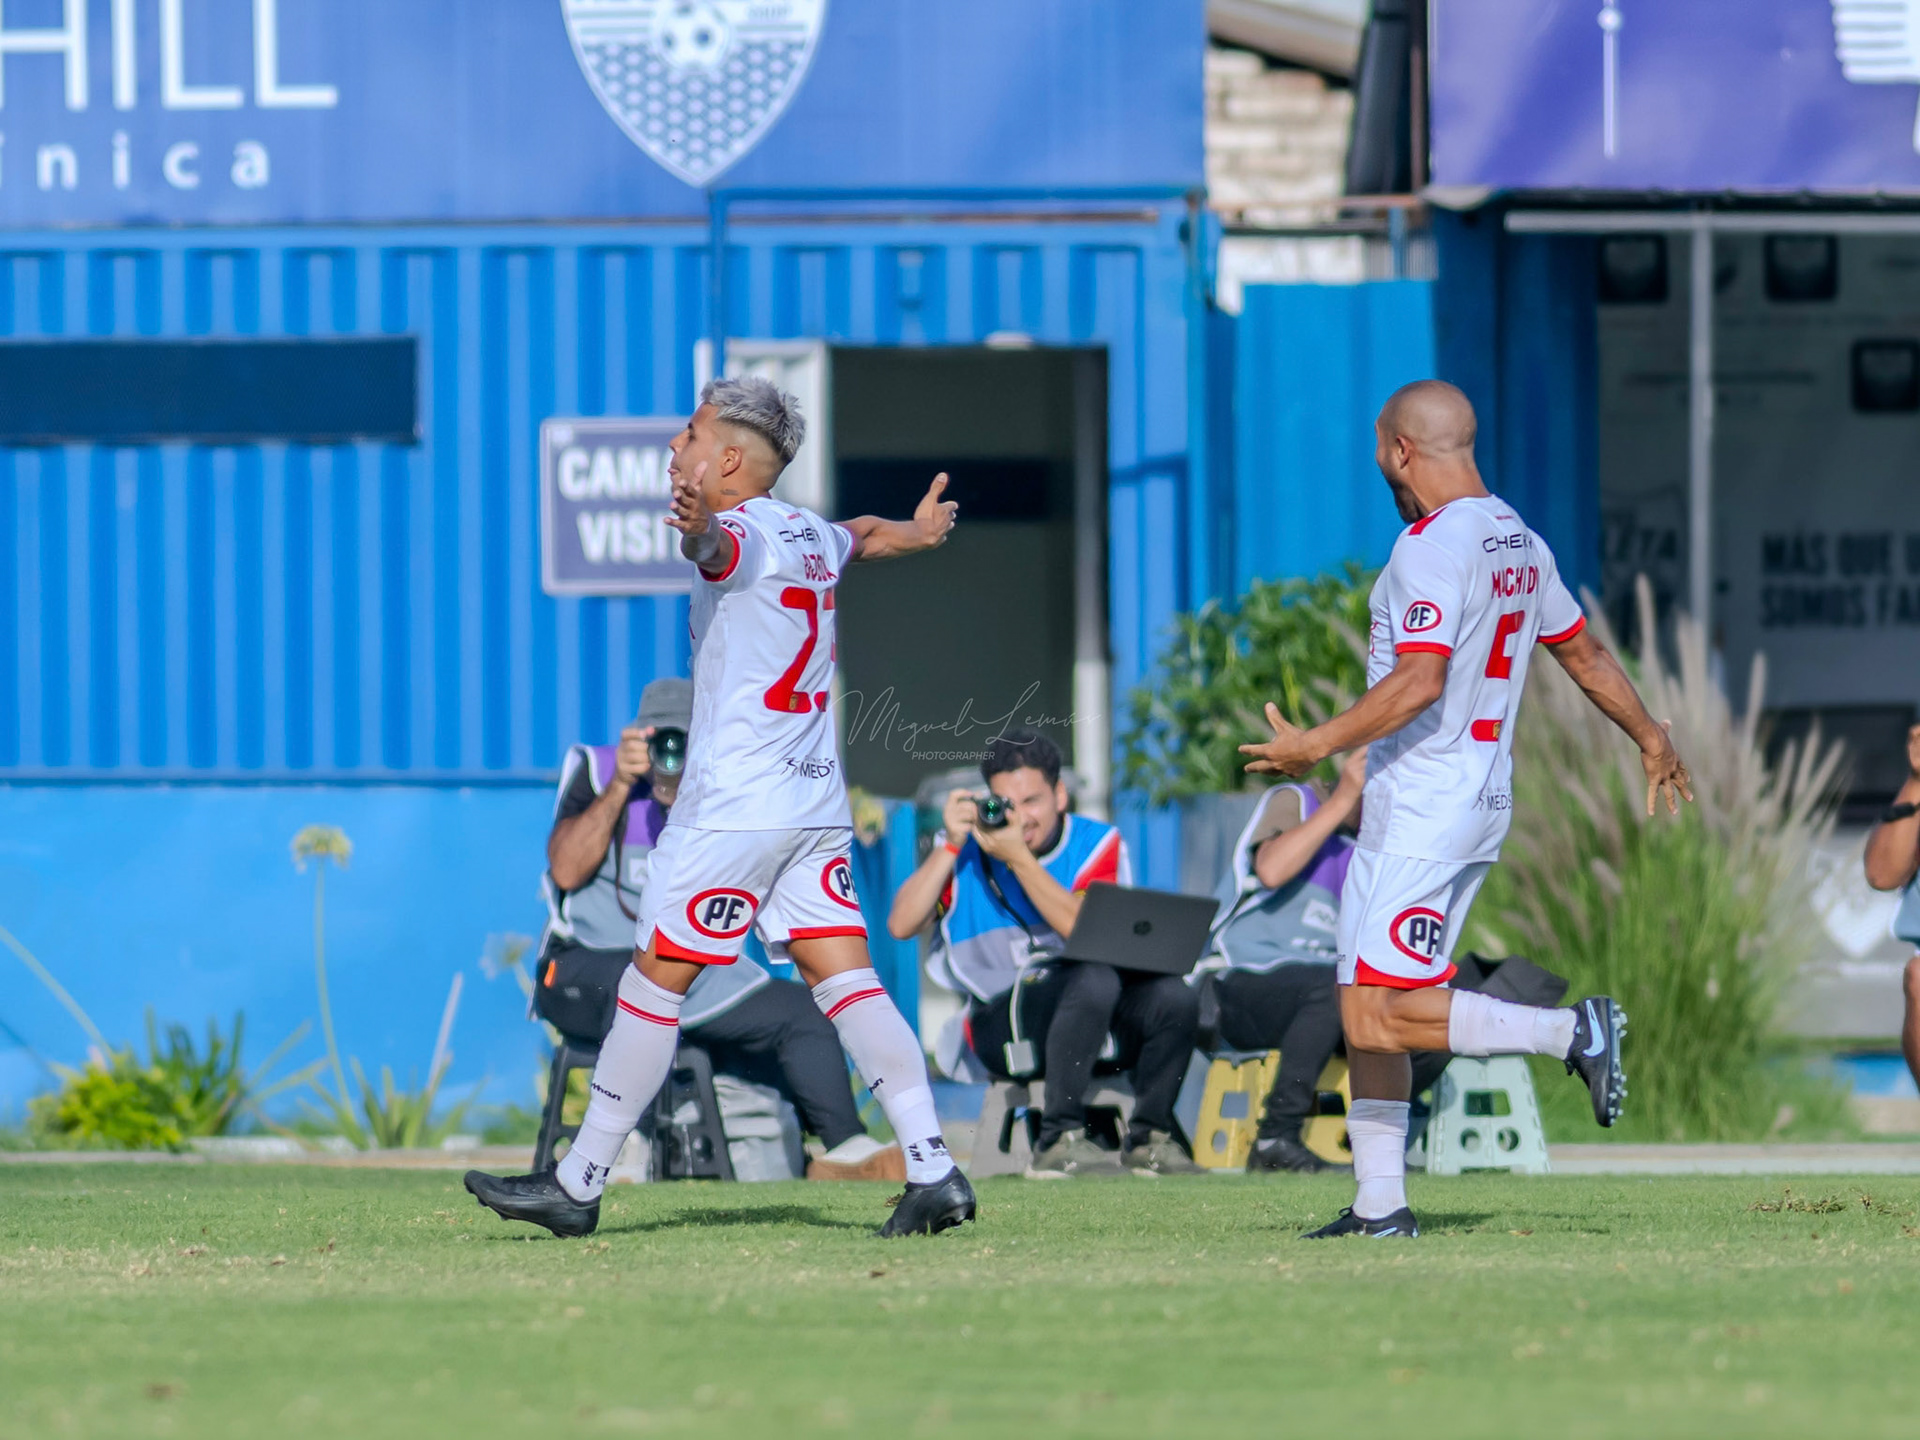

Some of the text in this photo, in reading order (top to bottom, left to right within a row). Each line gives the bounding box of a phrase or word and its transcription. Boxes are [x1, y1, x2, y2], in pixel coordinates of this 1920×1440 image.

[0, 131, 270, 190] nica
[577, 510, 685, 563] VISI
[1410, 606, 1431, 628] PF
[703, 896, 746, 930] PF
